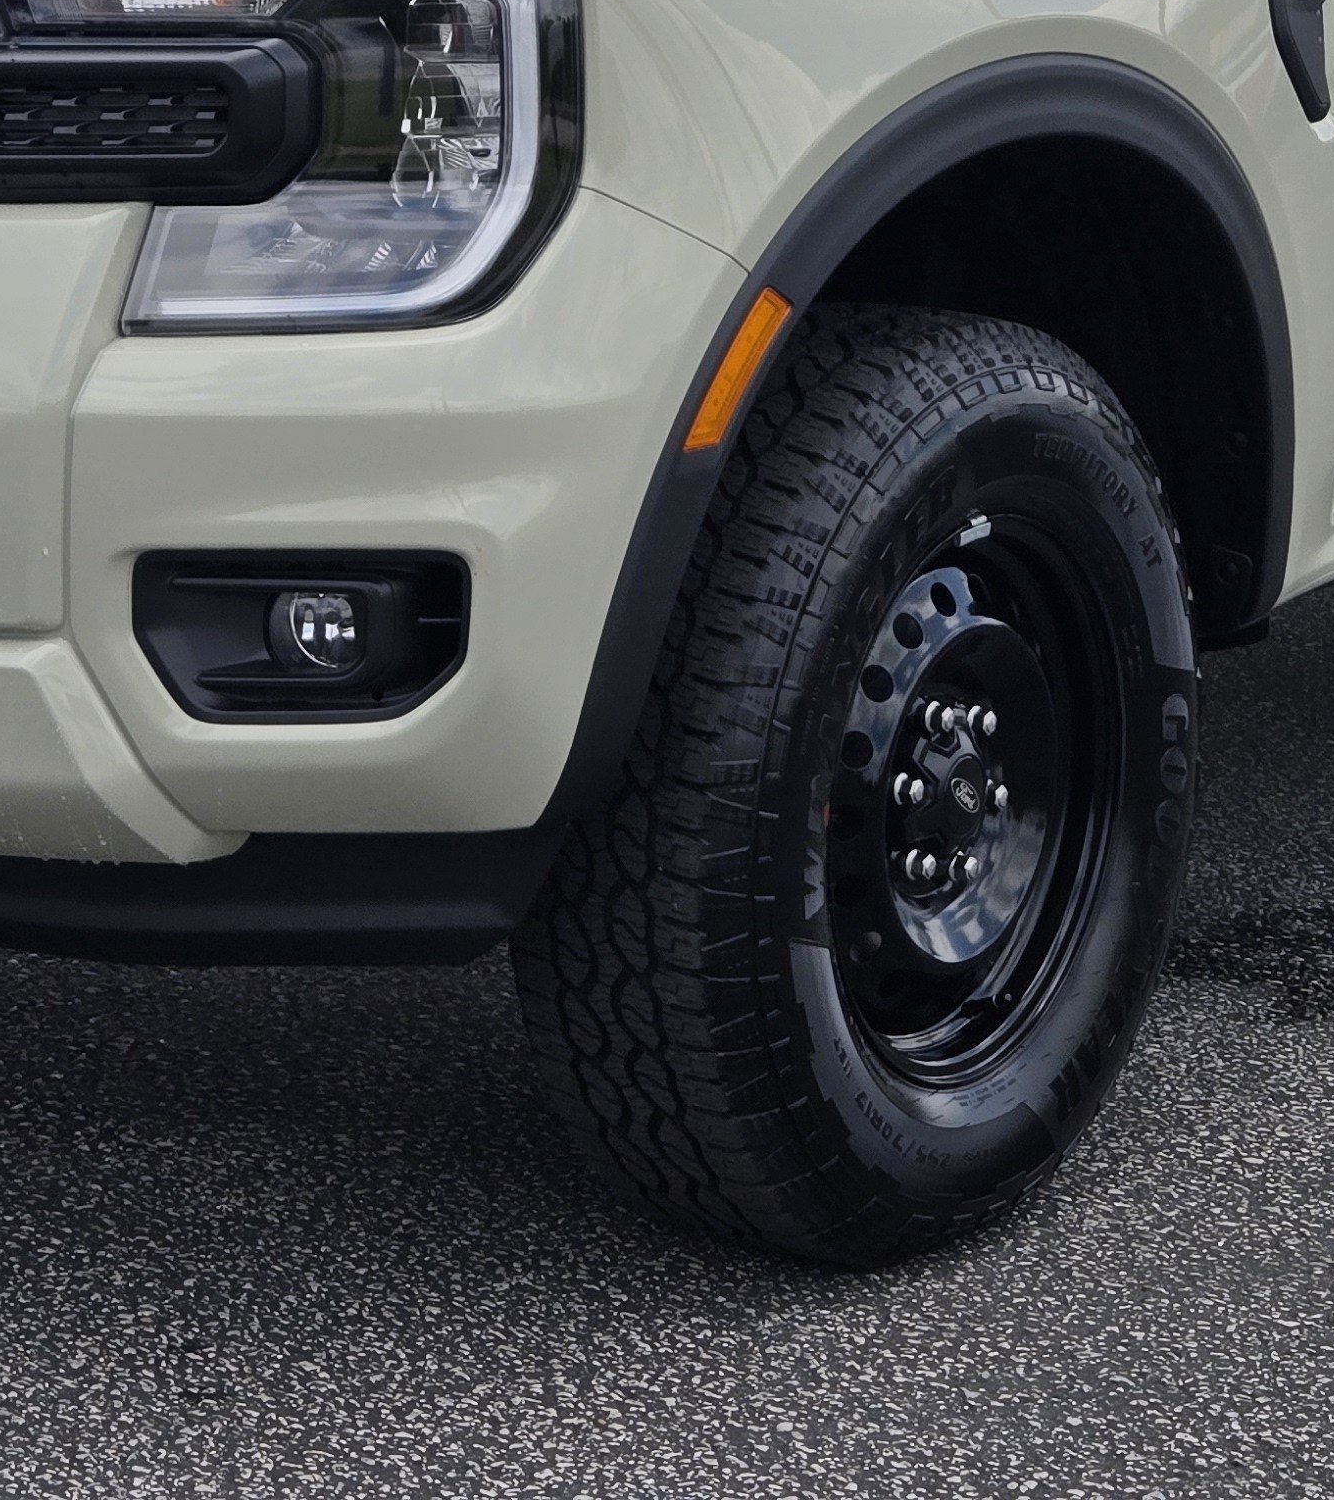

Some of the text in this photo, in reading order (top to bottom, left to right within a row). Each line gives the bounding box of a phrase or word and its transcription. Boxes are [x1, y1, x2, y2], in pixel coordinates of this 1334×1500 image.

[1033, 432, 1163, 568] TERRITORY AT
[955, 781, 977, 810] Ford
